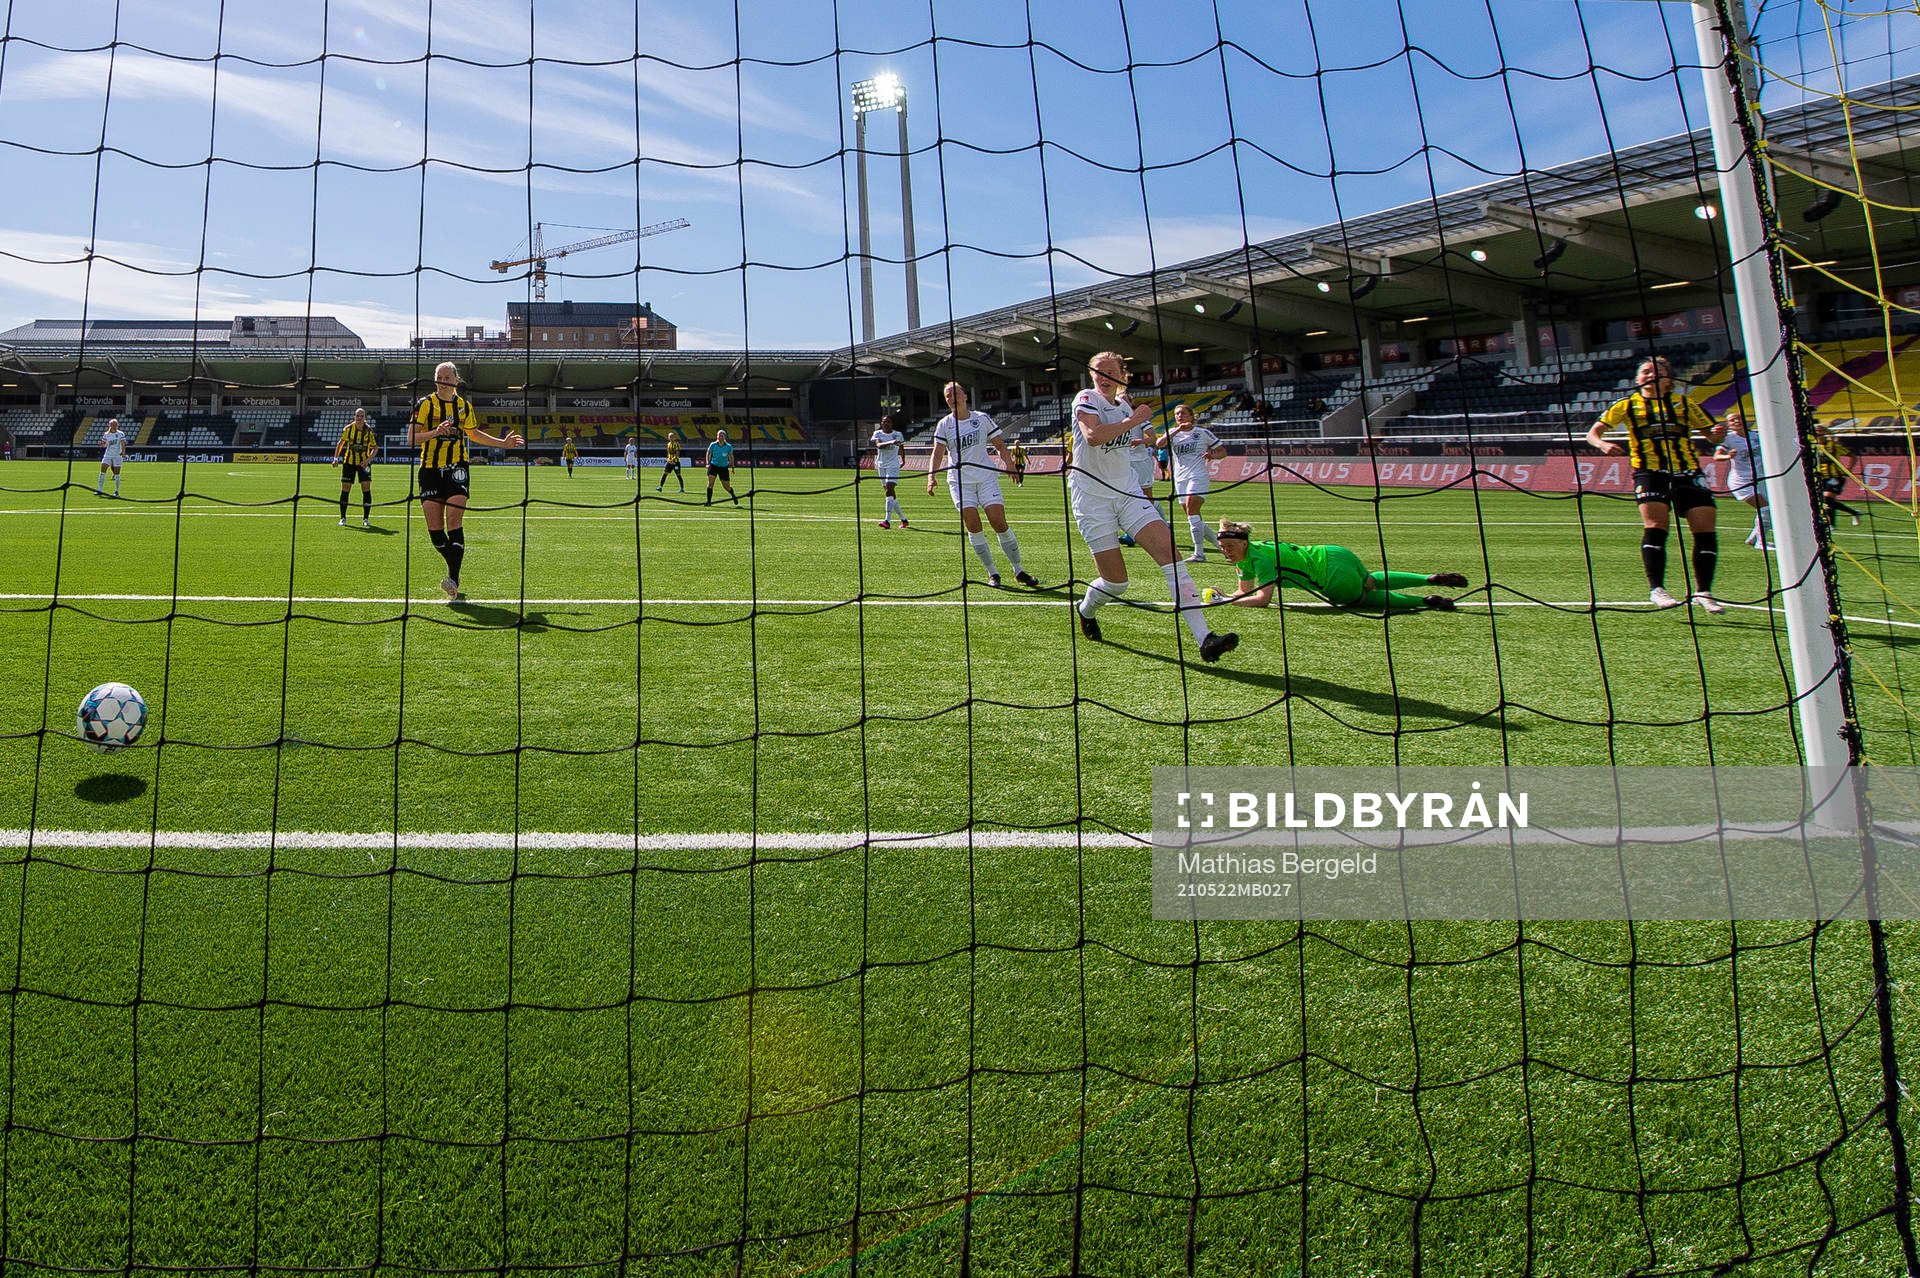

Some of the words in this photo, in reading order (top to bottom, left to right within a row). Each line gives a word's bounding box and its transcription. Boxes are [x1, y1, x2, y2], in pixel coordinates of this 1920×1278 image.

[83, 395, 113, 405] bravida
[250, 397, 280, 406] bravida
[332, 397, 361, 406] bravida
[581, 398, 610, 407] bravida
[663, 398, 691, 408] bravida
